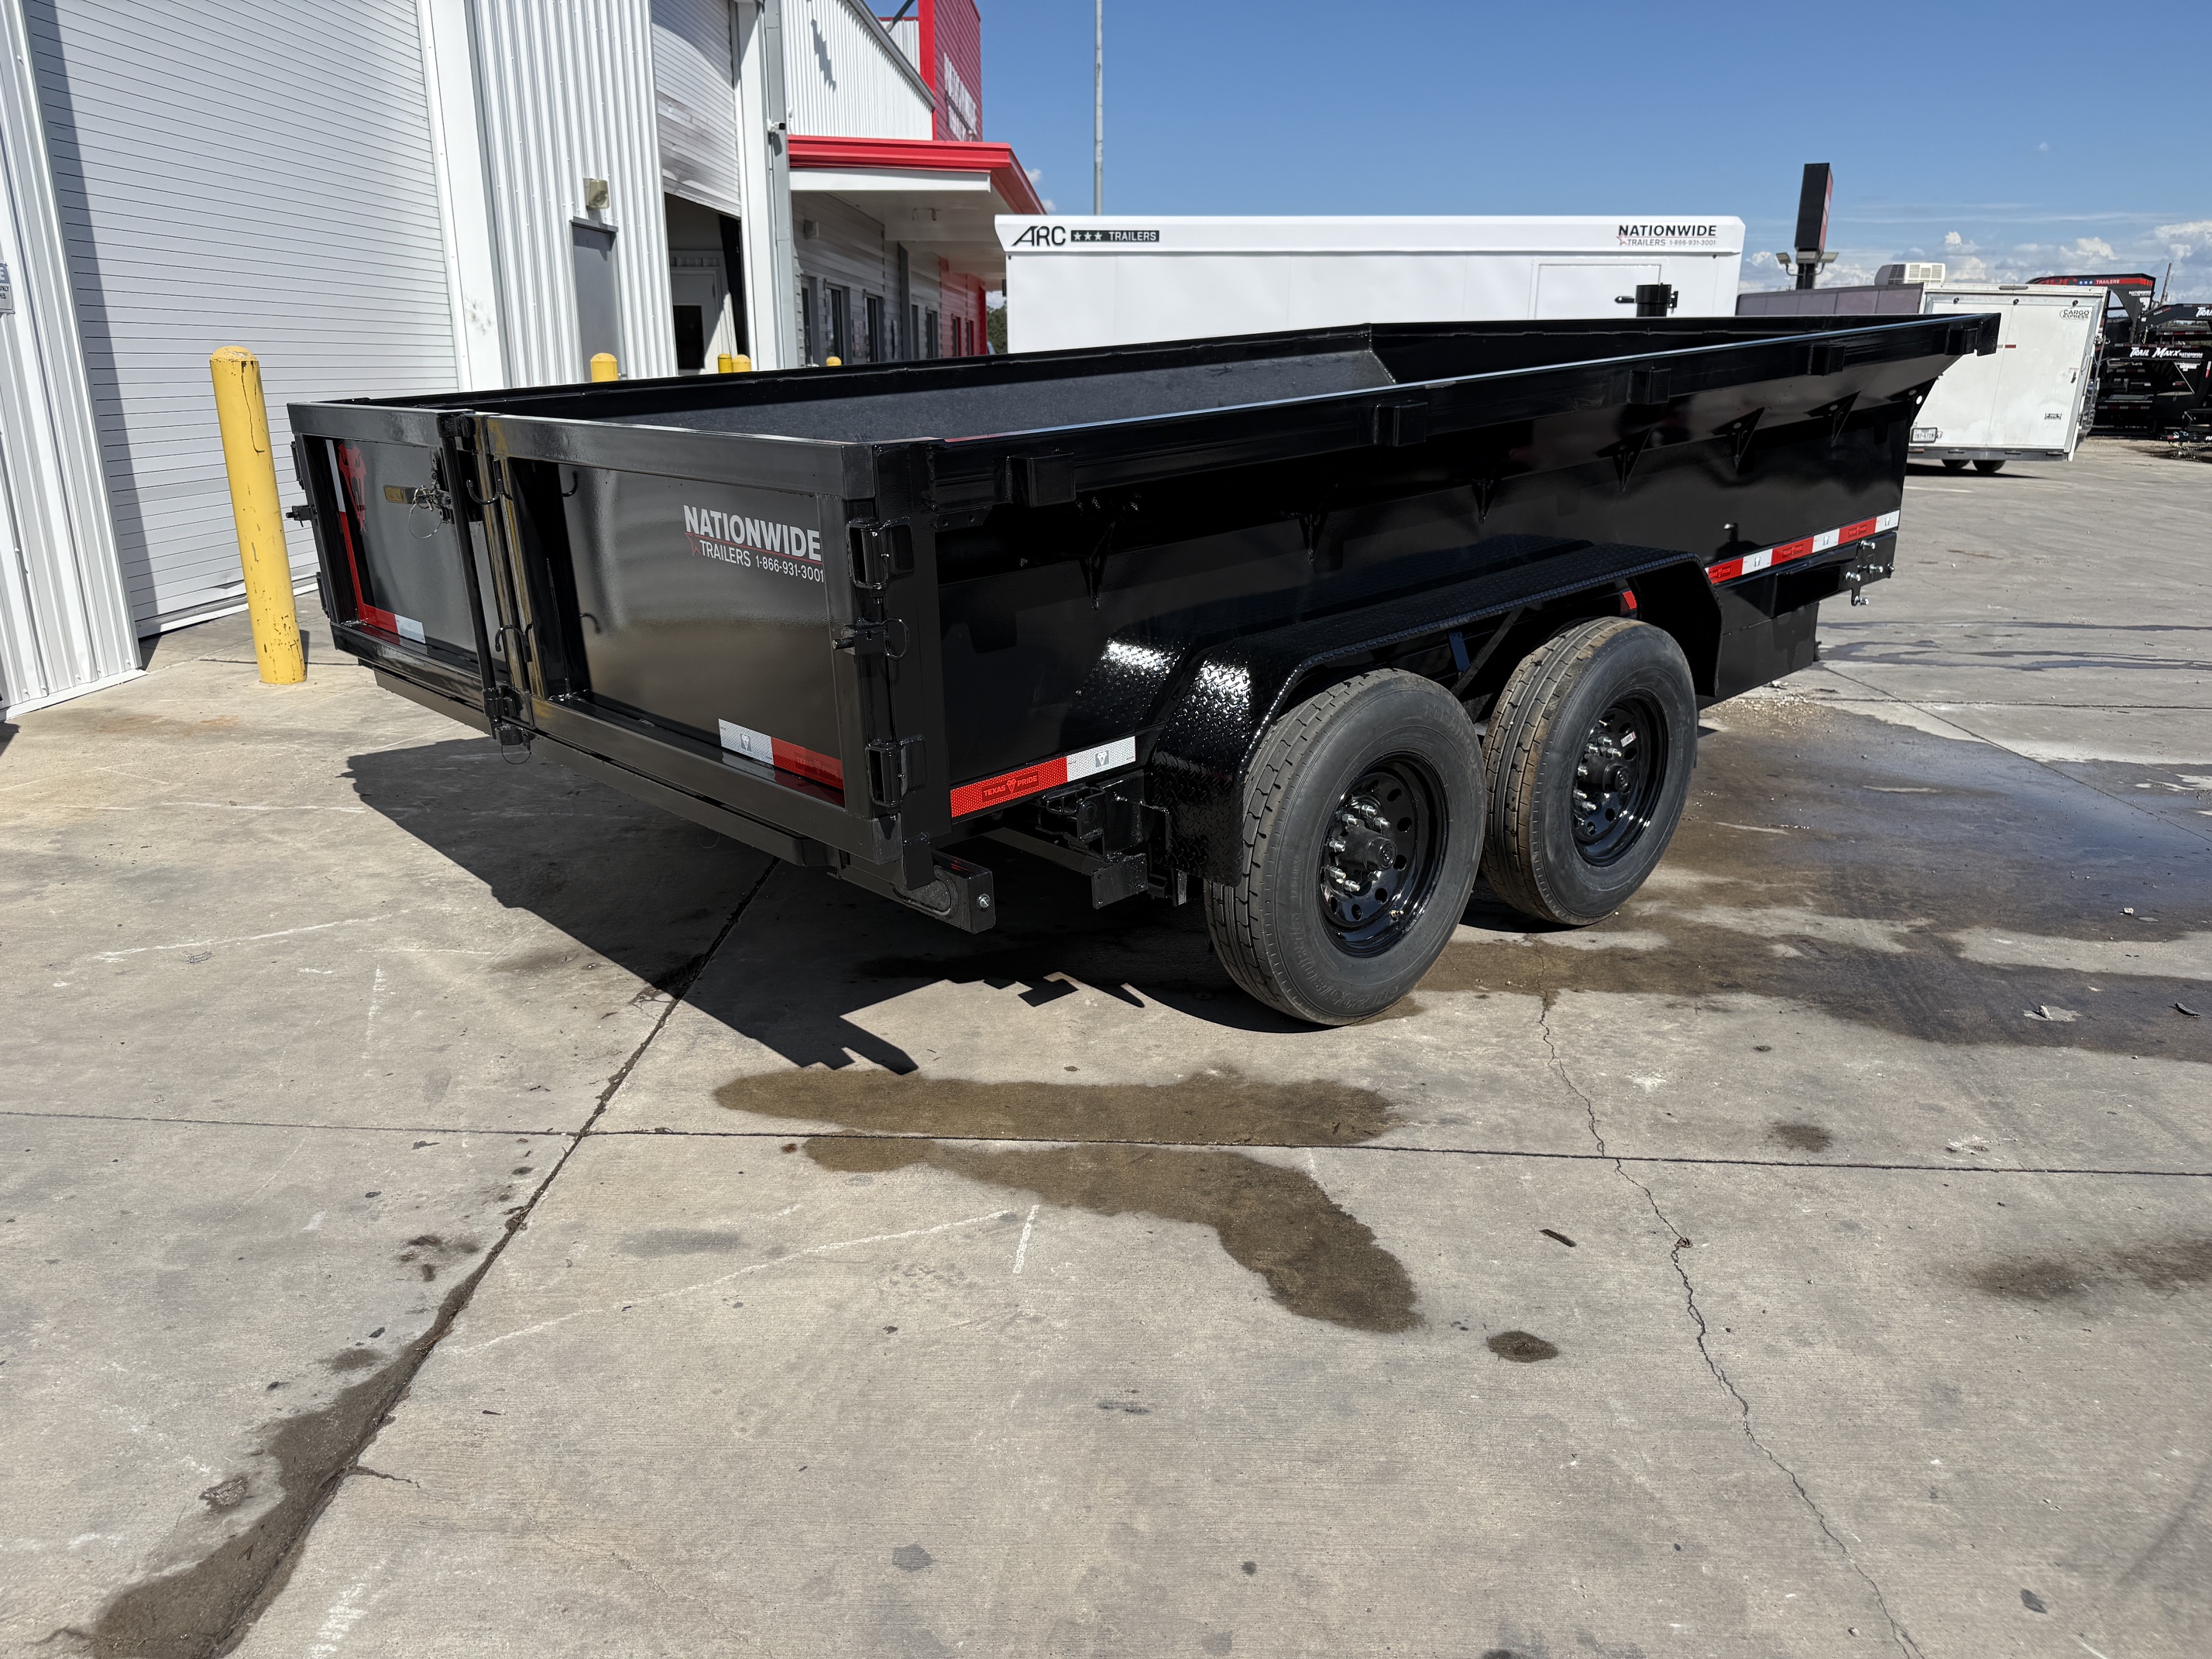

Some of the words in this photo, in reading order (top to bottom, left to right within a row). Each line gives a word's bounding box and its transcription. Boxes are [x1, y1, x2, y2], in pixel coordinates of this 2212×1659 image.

[1011, 225, 1066, 246] ARC
[1108, 232, 1157, 242] TRAILERS
[1618, 225, 1717, 236] NATIONWIDE
[683, 504, 822, 562] NATIONWIDE
[699, 539, 751, 568] TRAILERS
[755, 555, 825, 583] 1-866-931-3001
[983, 785, 1007, 797] TEXAS
[1017, 775, 1038, 787] PRIDE
